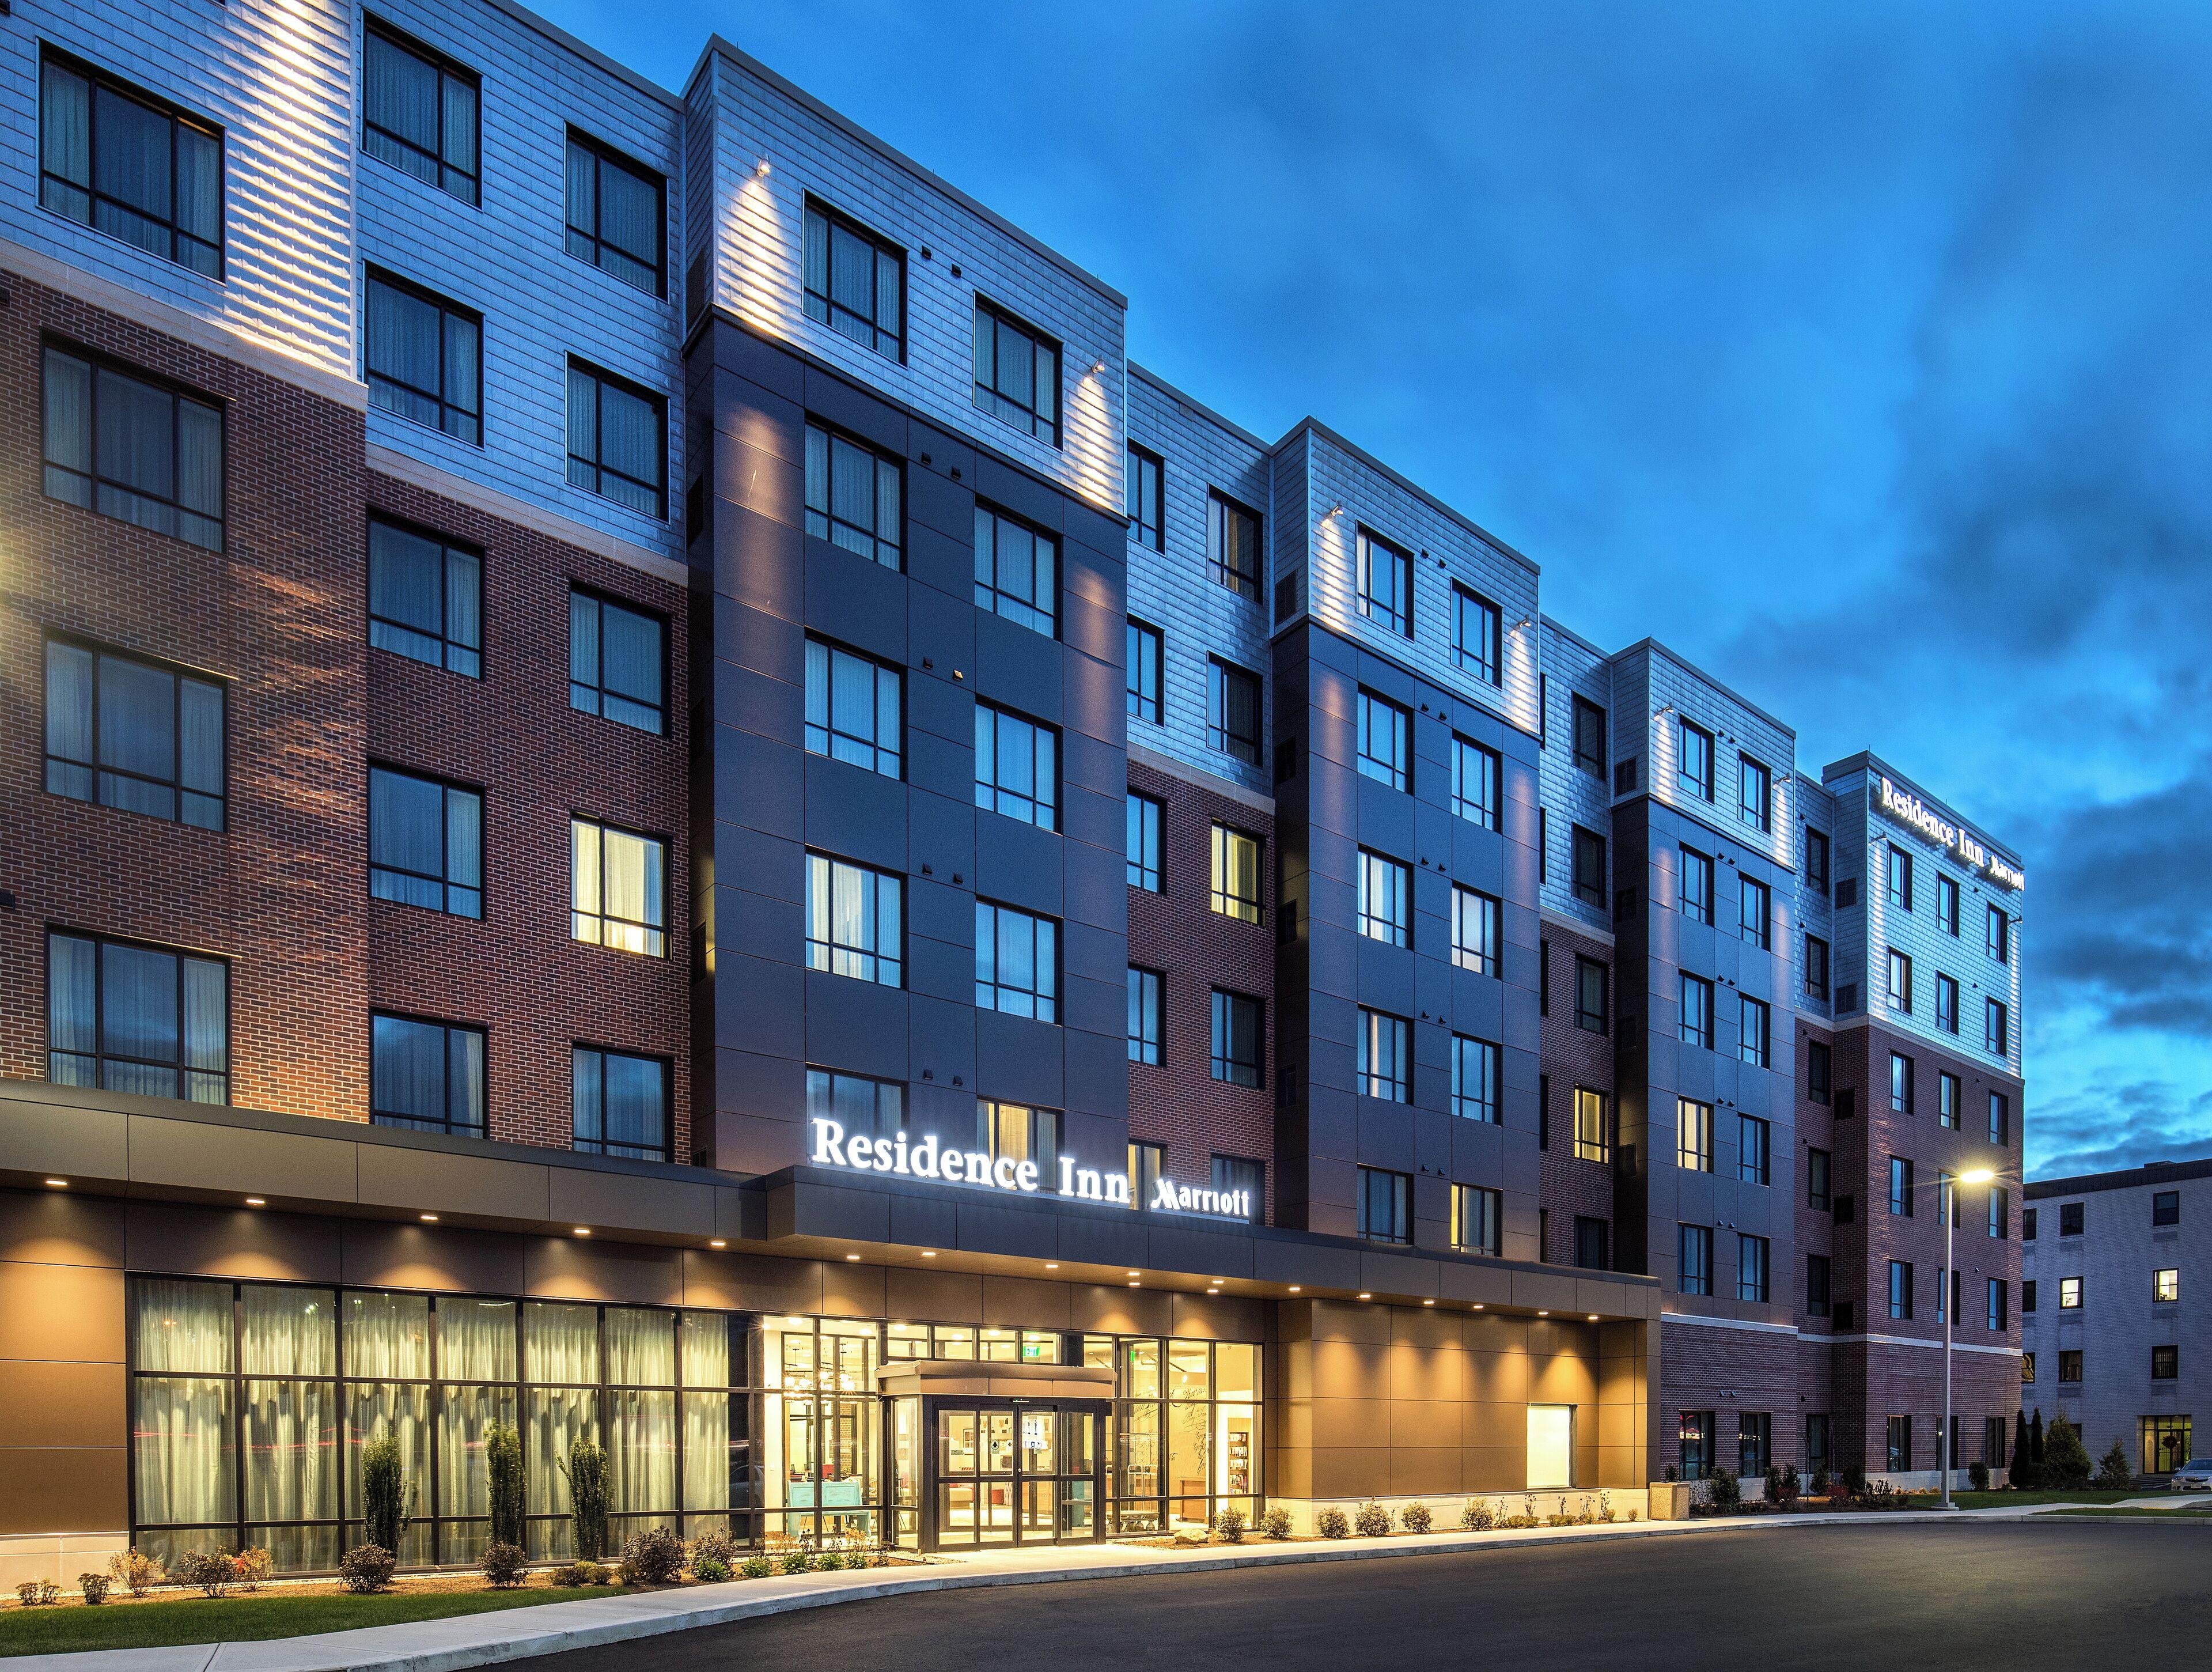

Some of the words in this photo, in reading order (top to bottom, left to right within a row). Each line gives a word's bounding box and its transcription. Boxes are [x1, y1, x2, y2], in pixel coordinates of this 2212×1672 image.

[1881, 777, 1955, 848] Residence
[1958, 829, 1985, 867] Inn
[812, 1118, 1038, 1191] Residence
[1059, 1156, 1131, 1204] Inn
[1150, 1178, 1249, 1216] Marriott
